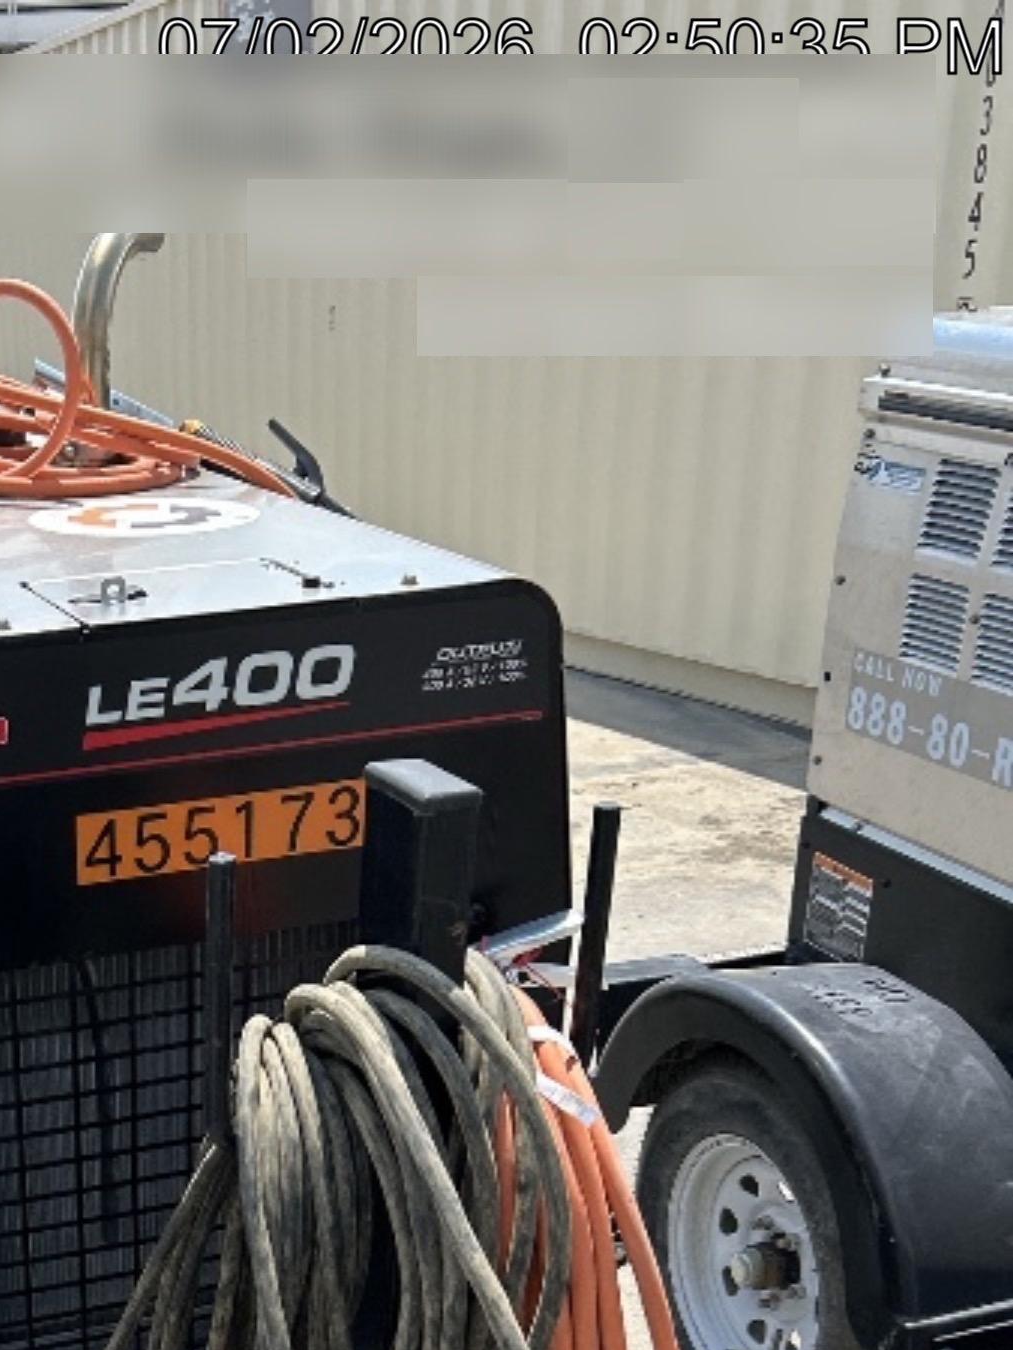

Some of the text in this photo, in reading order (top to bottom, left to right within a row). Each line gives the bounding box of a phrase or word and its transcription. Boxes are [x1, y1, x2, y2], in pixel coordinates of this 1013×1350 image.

[85, 644, 355, 727] LE400
[853, 652, 943, 696] CALL NOW
[85, 785, 361, 877] 455173
